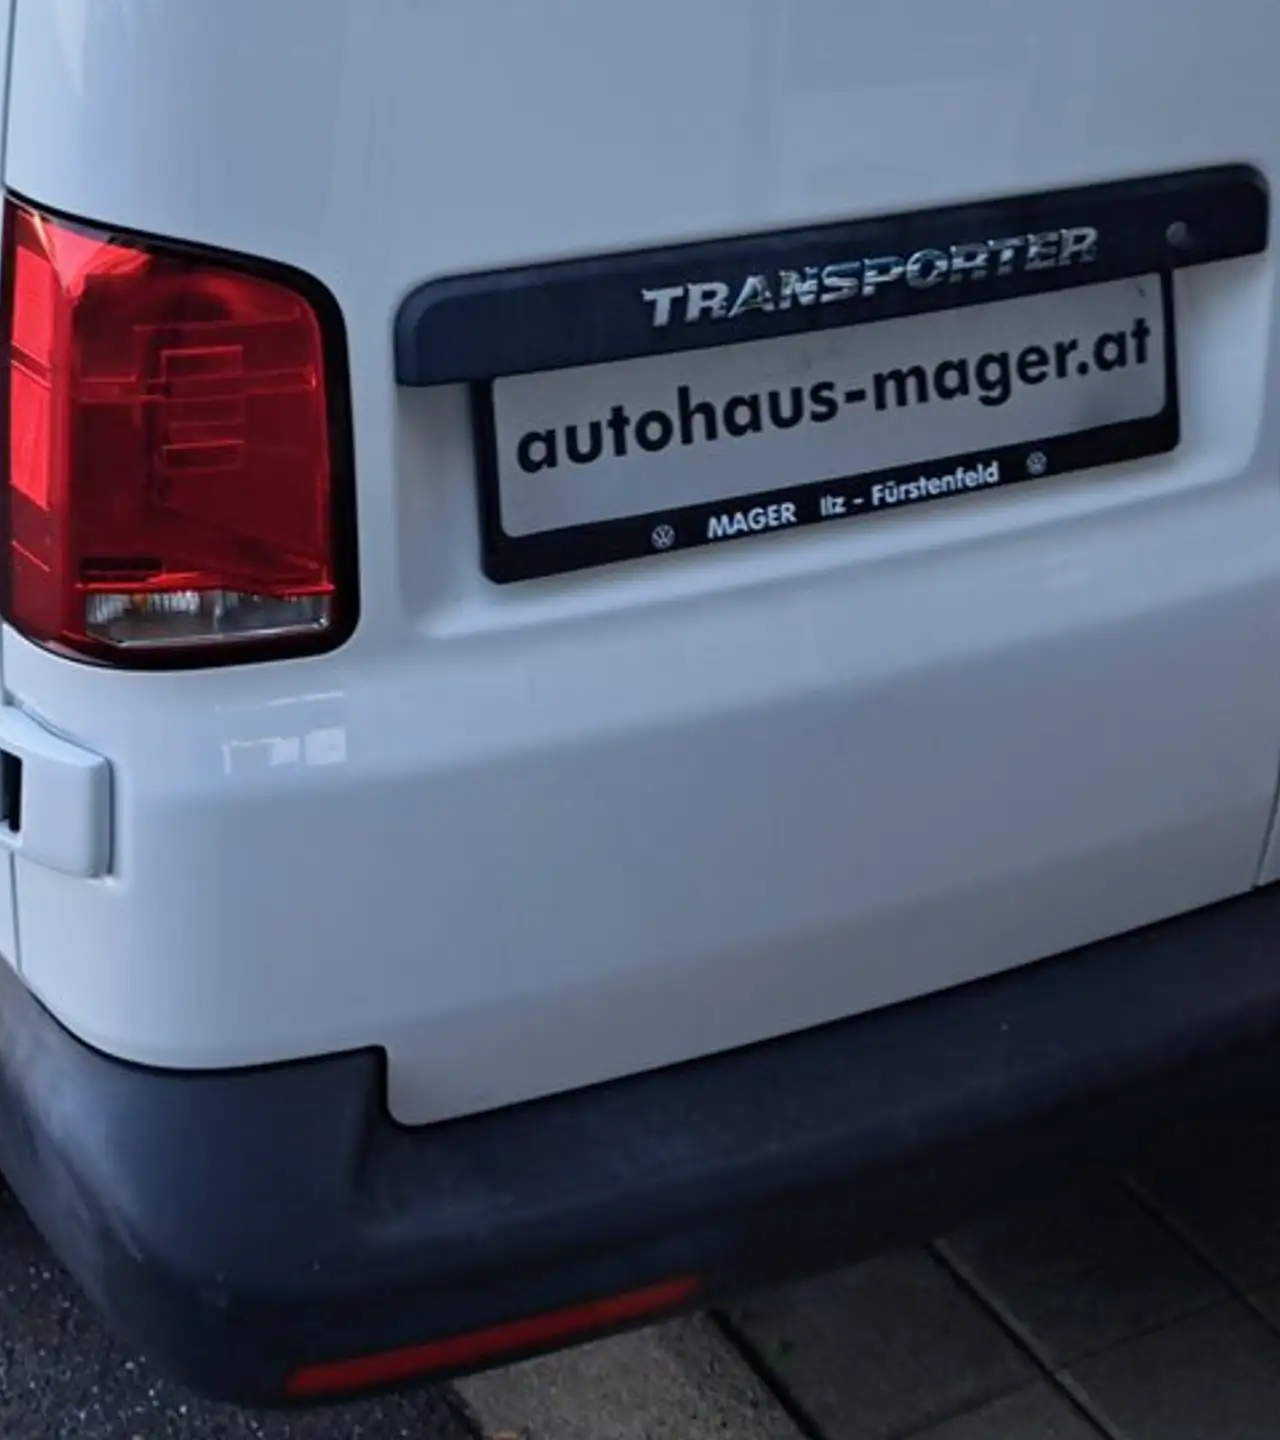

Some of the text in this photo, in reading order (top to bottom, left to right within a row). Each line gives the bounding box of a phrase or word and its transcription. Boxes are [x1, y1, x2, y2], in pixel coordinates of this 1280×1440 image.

[641, 226, 1100, 328] TRANSPORTER
[516, 317, 1152, 474] autohaus-mager.at
[706, 501, 798, 540] MAGER
[820, 493, 847, 518] Ilz
[871, 460, 1001, 507] Fürstenfeld
